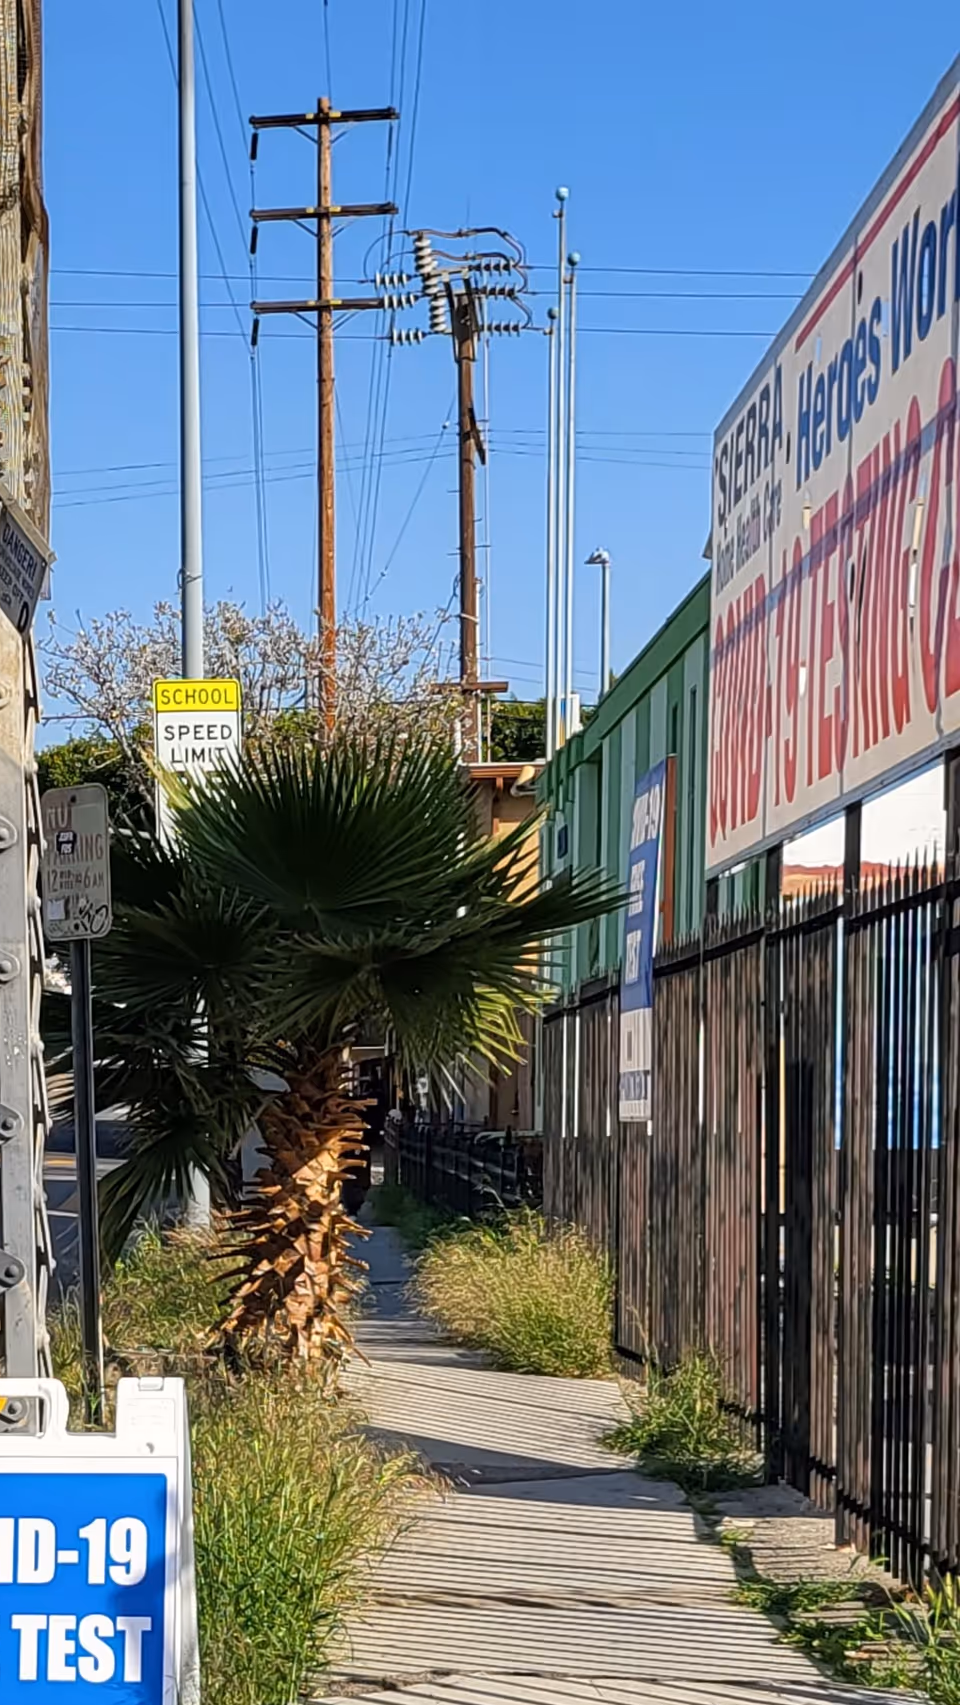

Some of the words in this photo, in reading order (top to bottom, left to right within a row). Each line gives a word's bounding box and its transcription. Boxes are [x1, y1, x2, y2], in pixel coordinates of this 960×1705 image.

[796, 296, 881, 492] Heroes
[718, 362, 783, 528] SIERRA
[2, 523, 37, 581] DANGER!
[806, 396, 922, 788] TESTING
[161, 688, 234, 705] SCHOOL
[164, 725, 233, 741] SPEED
[11, 1614, 152, 1683] TEST
